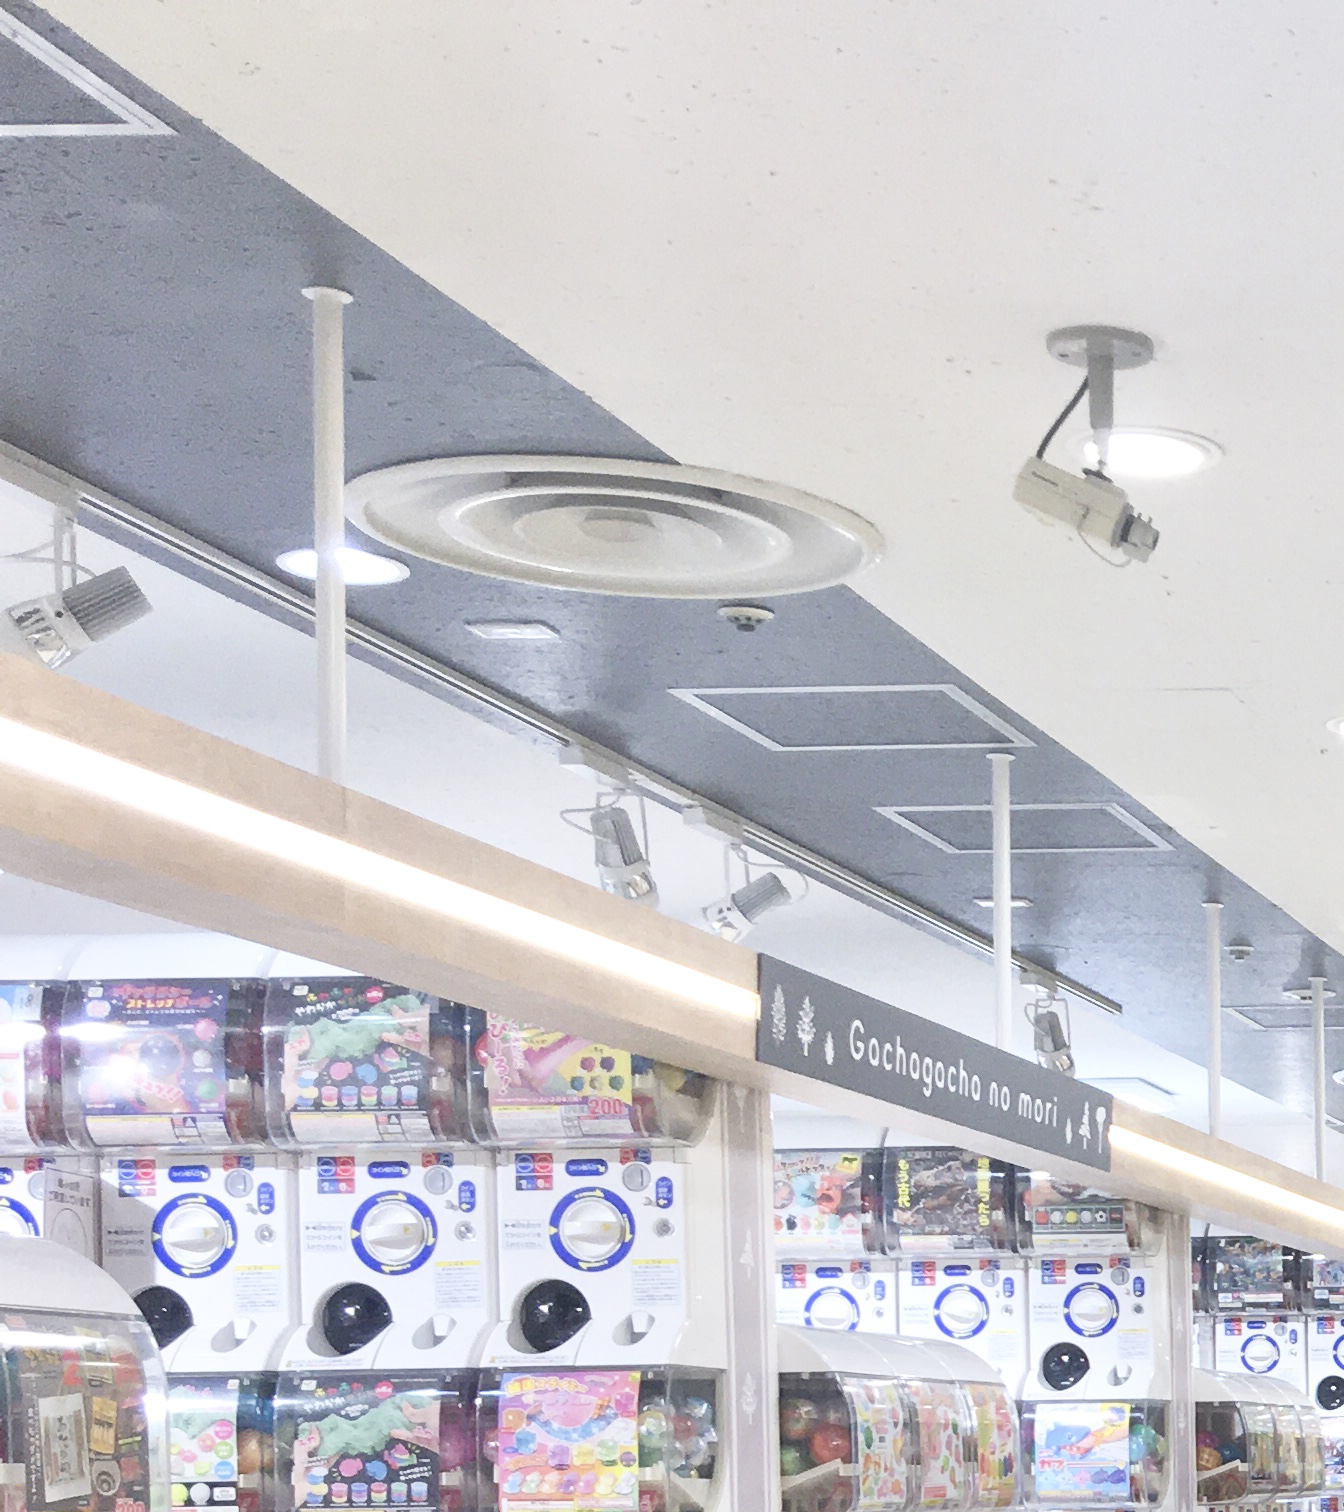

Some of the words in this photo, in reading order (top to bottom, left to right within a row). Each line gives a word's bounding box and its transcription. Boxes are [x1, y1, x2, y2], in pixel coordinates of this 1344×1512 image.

[849, 1019, 981, 1101] Gachagacha
[989, 1082, 1010, 1112] no
[1018, 1091, 1058, 1128] mori
